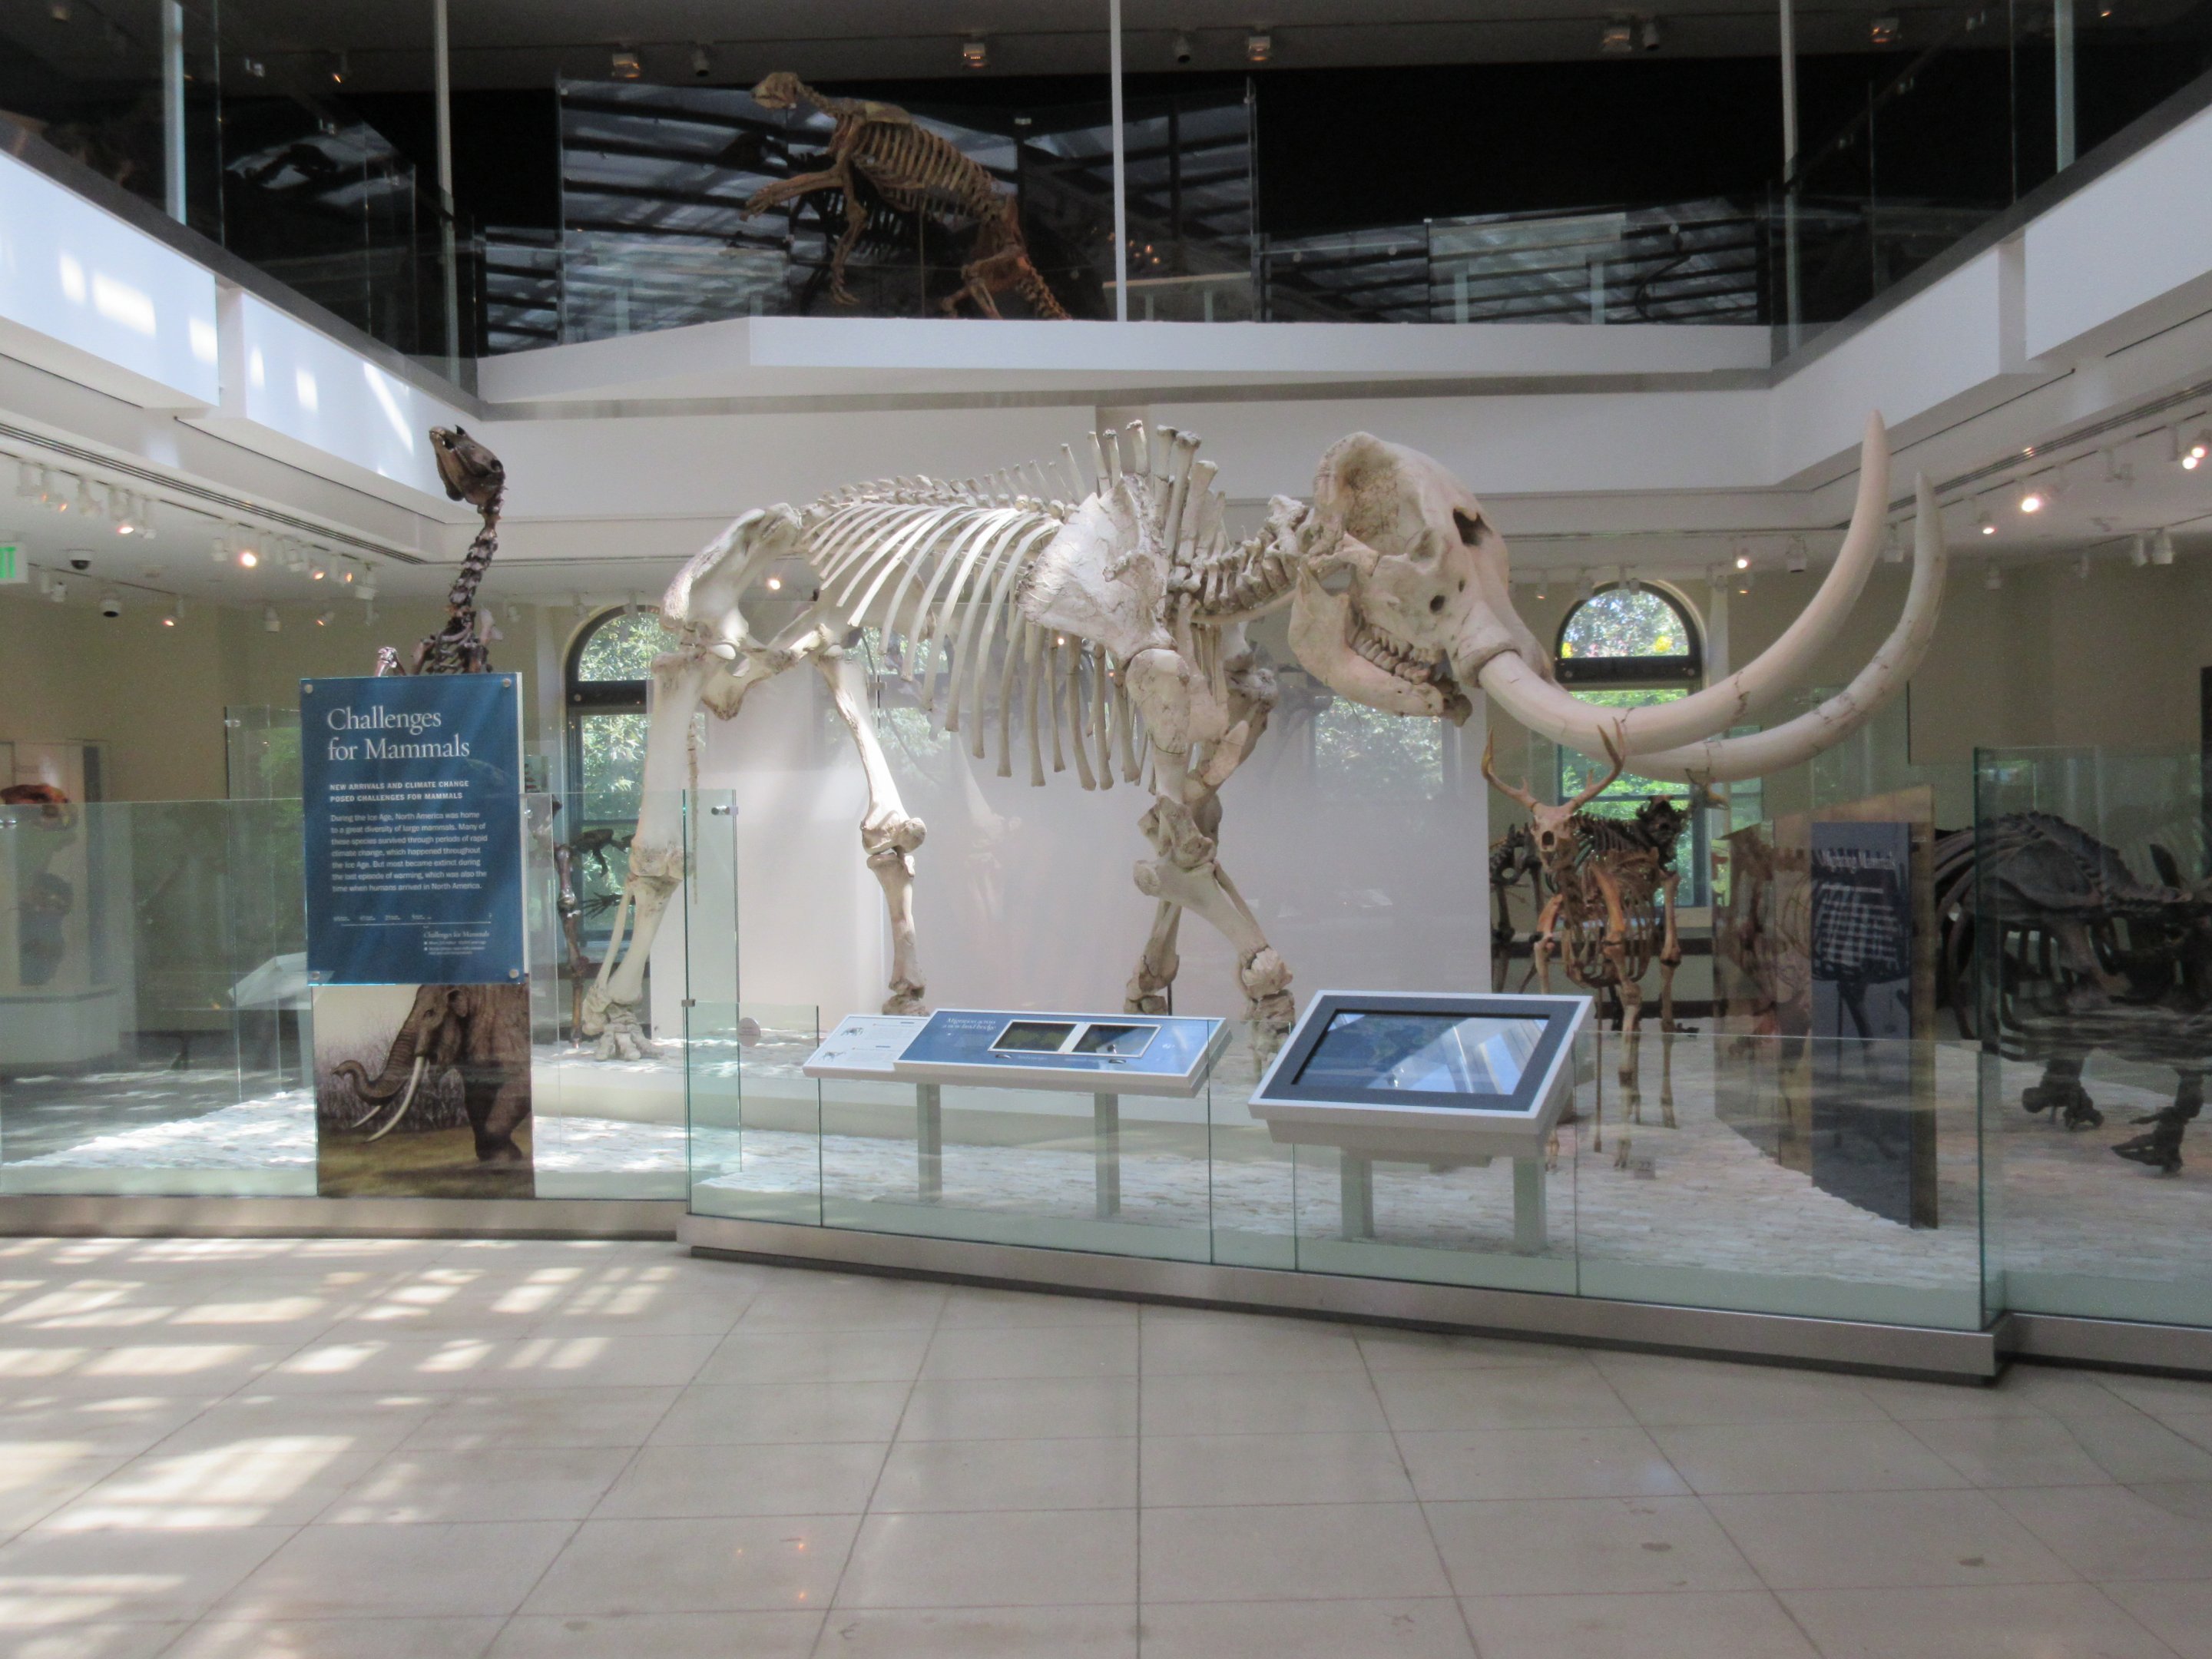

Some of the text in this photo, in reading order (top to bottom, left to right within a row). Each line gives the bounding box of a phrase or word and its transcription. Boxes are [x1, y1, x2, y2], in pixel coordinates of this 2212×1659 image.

[327, 706, 442, 736] Challenges
[328, 733, 470, 760] for Mammals
[331, 815, 353, 823] During
[408, 848, 442, 856] happened
